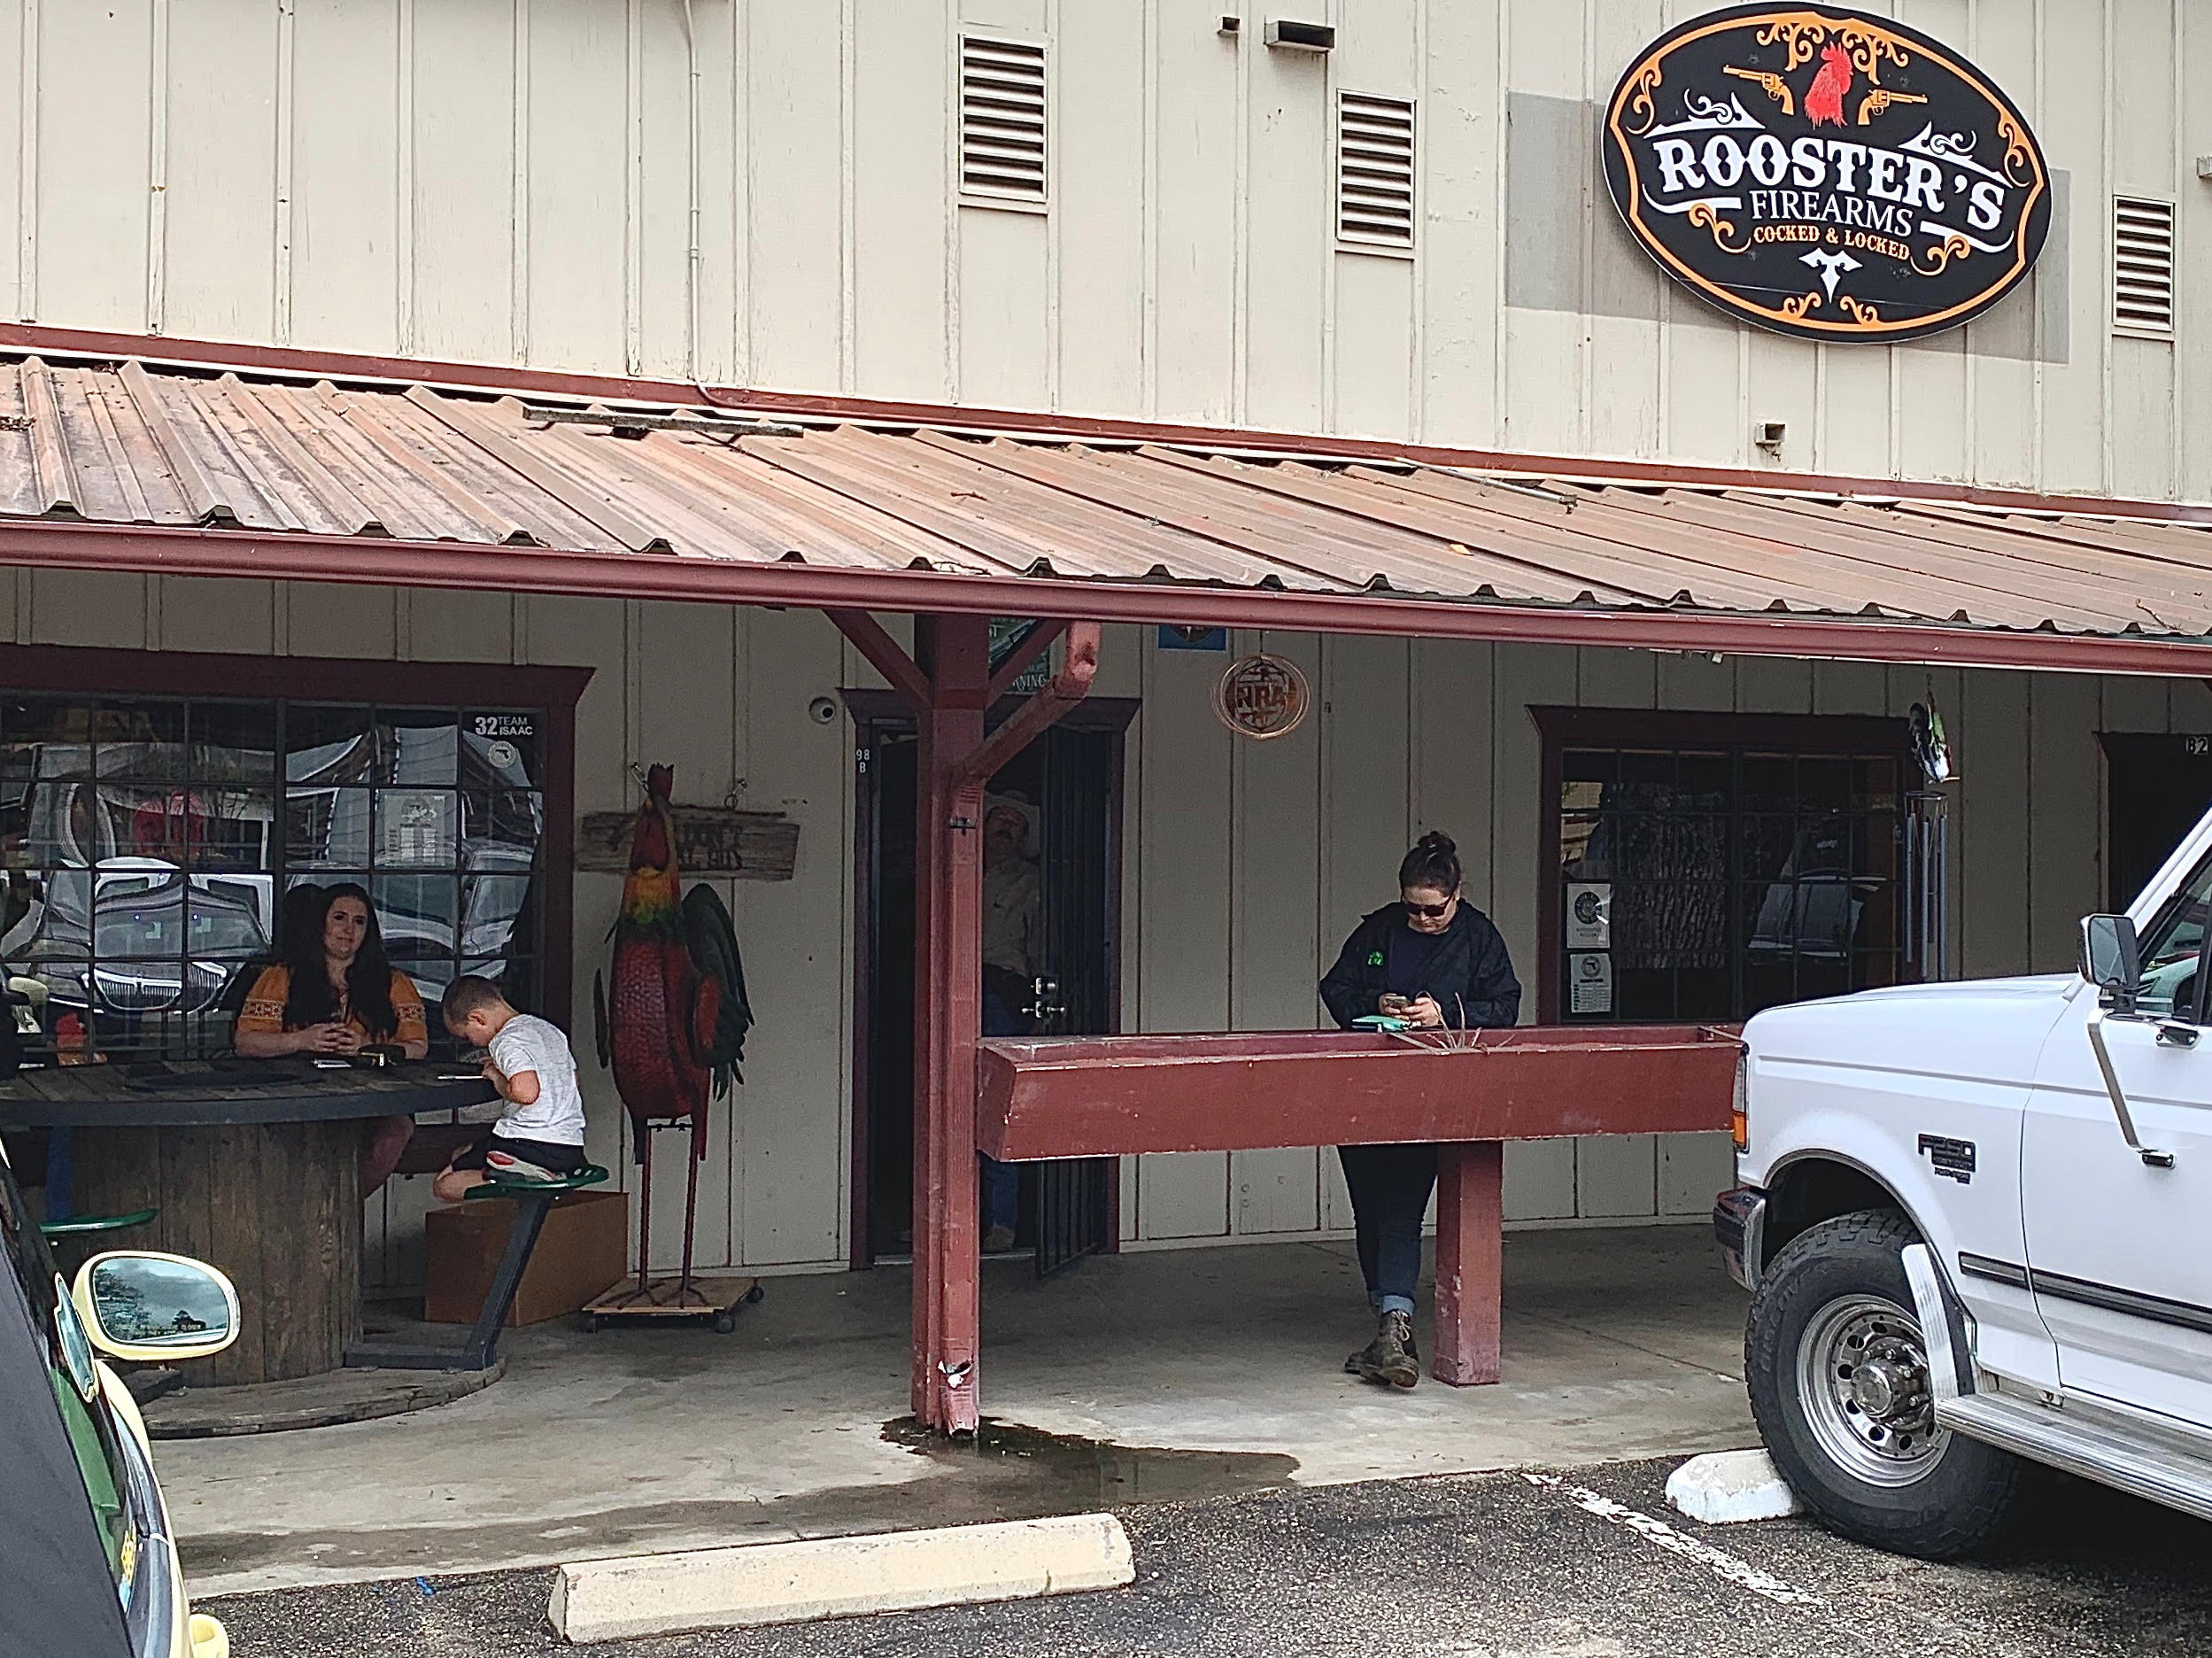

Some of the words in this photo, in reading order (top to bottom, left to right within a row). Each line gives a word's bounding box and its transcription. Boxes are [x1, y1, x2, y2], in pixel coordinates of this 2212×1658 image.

[1653, 135, 2006, 231] ROOSTER'S
[1751, 190, 1913, 237] FIREARMS
[1752, 225, 1821, 244] COCKED
[1826, 227, 1837, 244] &
[1845, 229, 1911, 260] LOCKED
[475, 717, 498, 735] 32
[498, 716, 528, 725] TEAM
[499, 726, 533, 736] ISAAC
[855, 748, 870, 761] 98
